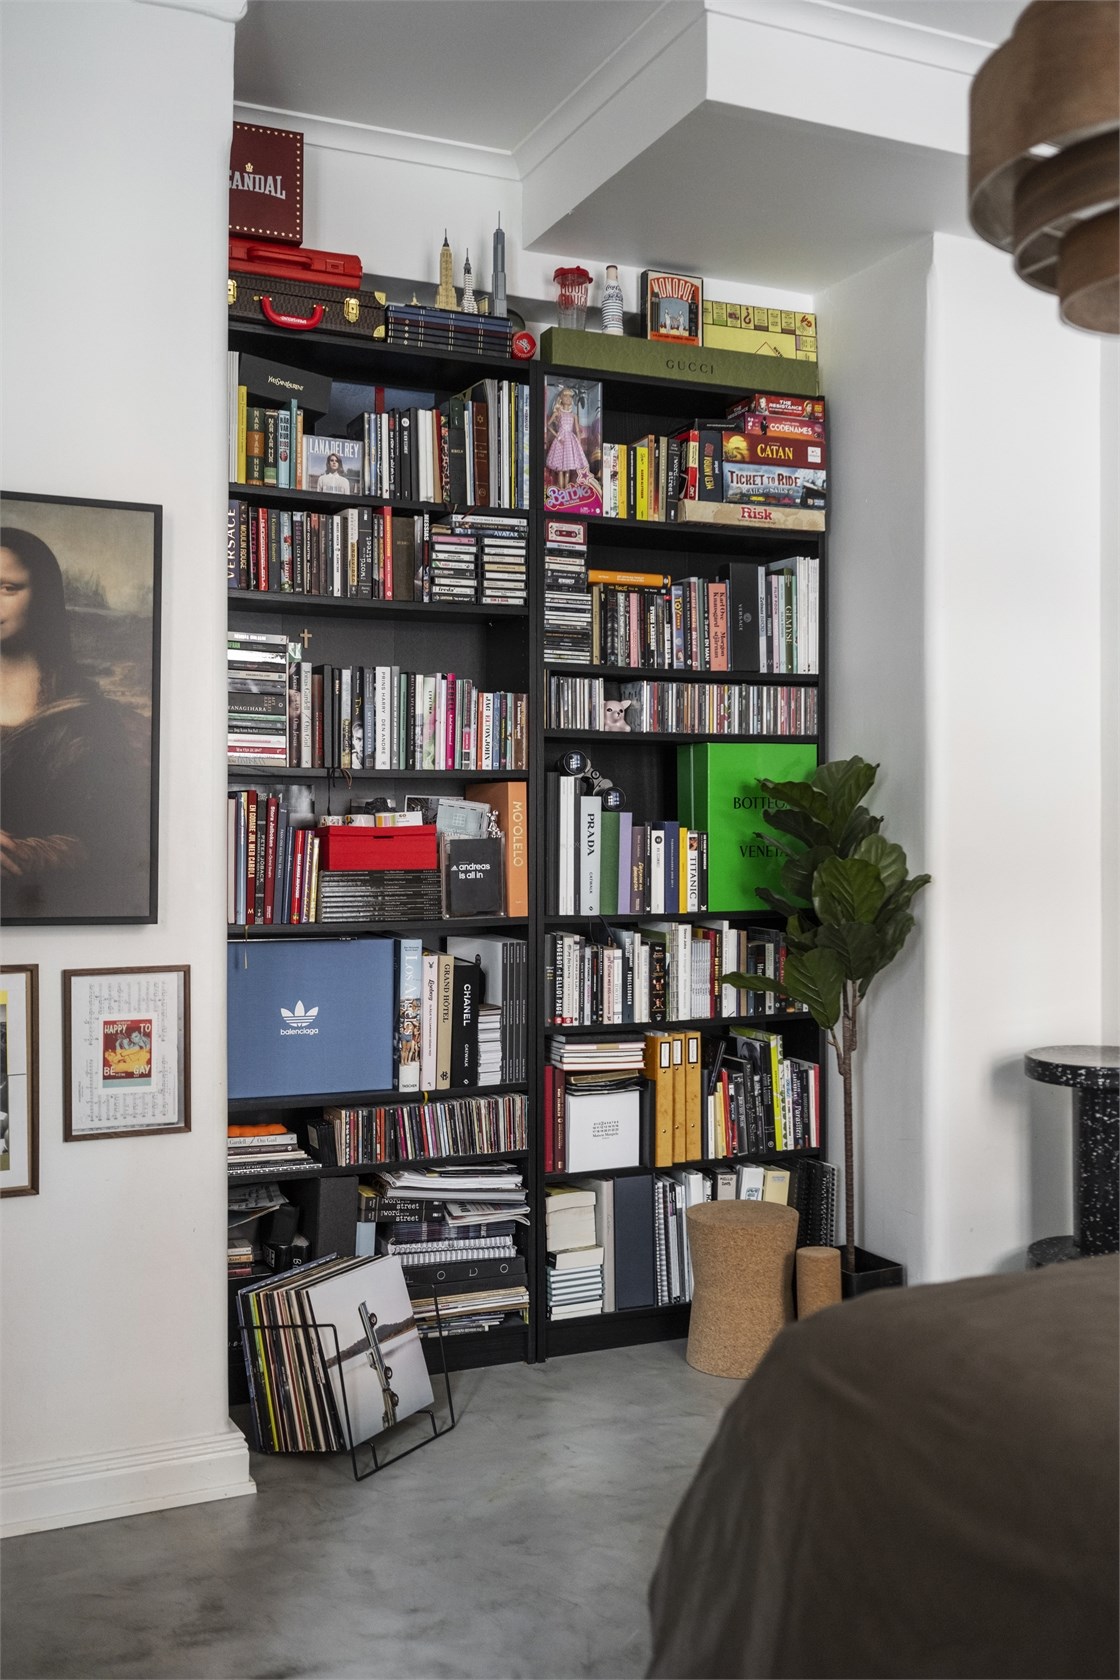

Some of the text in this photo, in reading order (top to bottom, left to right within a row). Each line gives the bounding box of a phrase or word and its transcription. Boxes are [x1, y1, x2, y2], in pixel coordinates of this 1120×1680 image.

[665, 359, 714, 375] GUCCI
[769, 403, 802, 411] RESISTANCE
[769, 423, 812, 435] CODENAMES
[309, 437, 359, 458] LANA DEL REY
[757, 444, 793, 460] CATAN
[728, 470, 800, 487] TICKET TO RIDE
[547, 484, 592, 506] Barbie
[740, 507, 772, 520] Risk
[494, 530, 519, 538] AVATAR
[304, 720, 310, 731] Om
[249, 804, 256, 812] EN
[733, 796, 787, 809] BOTTEG
[587, 813, 595, 856] PRADA
[458, 870, 483, 879] is all in
[689, 856, 697, 899] TITANIC
[463, 983, 472, 1026] CHANEL
[104, 1023, 151, 1034] HAPPY TO
[280, 1028, 319, 1036] balenciaga
[103, 1064, 151, 1076] BE GAY
